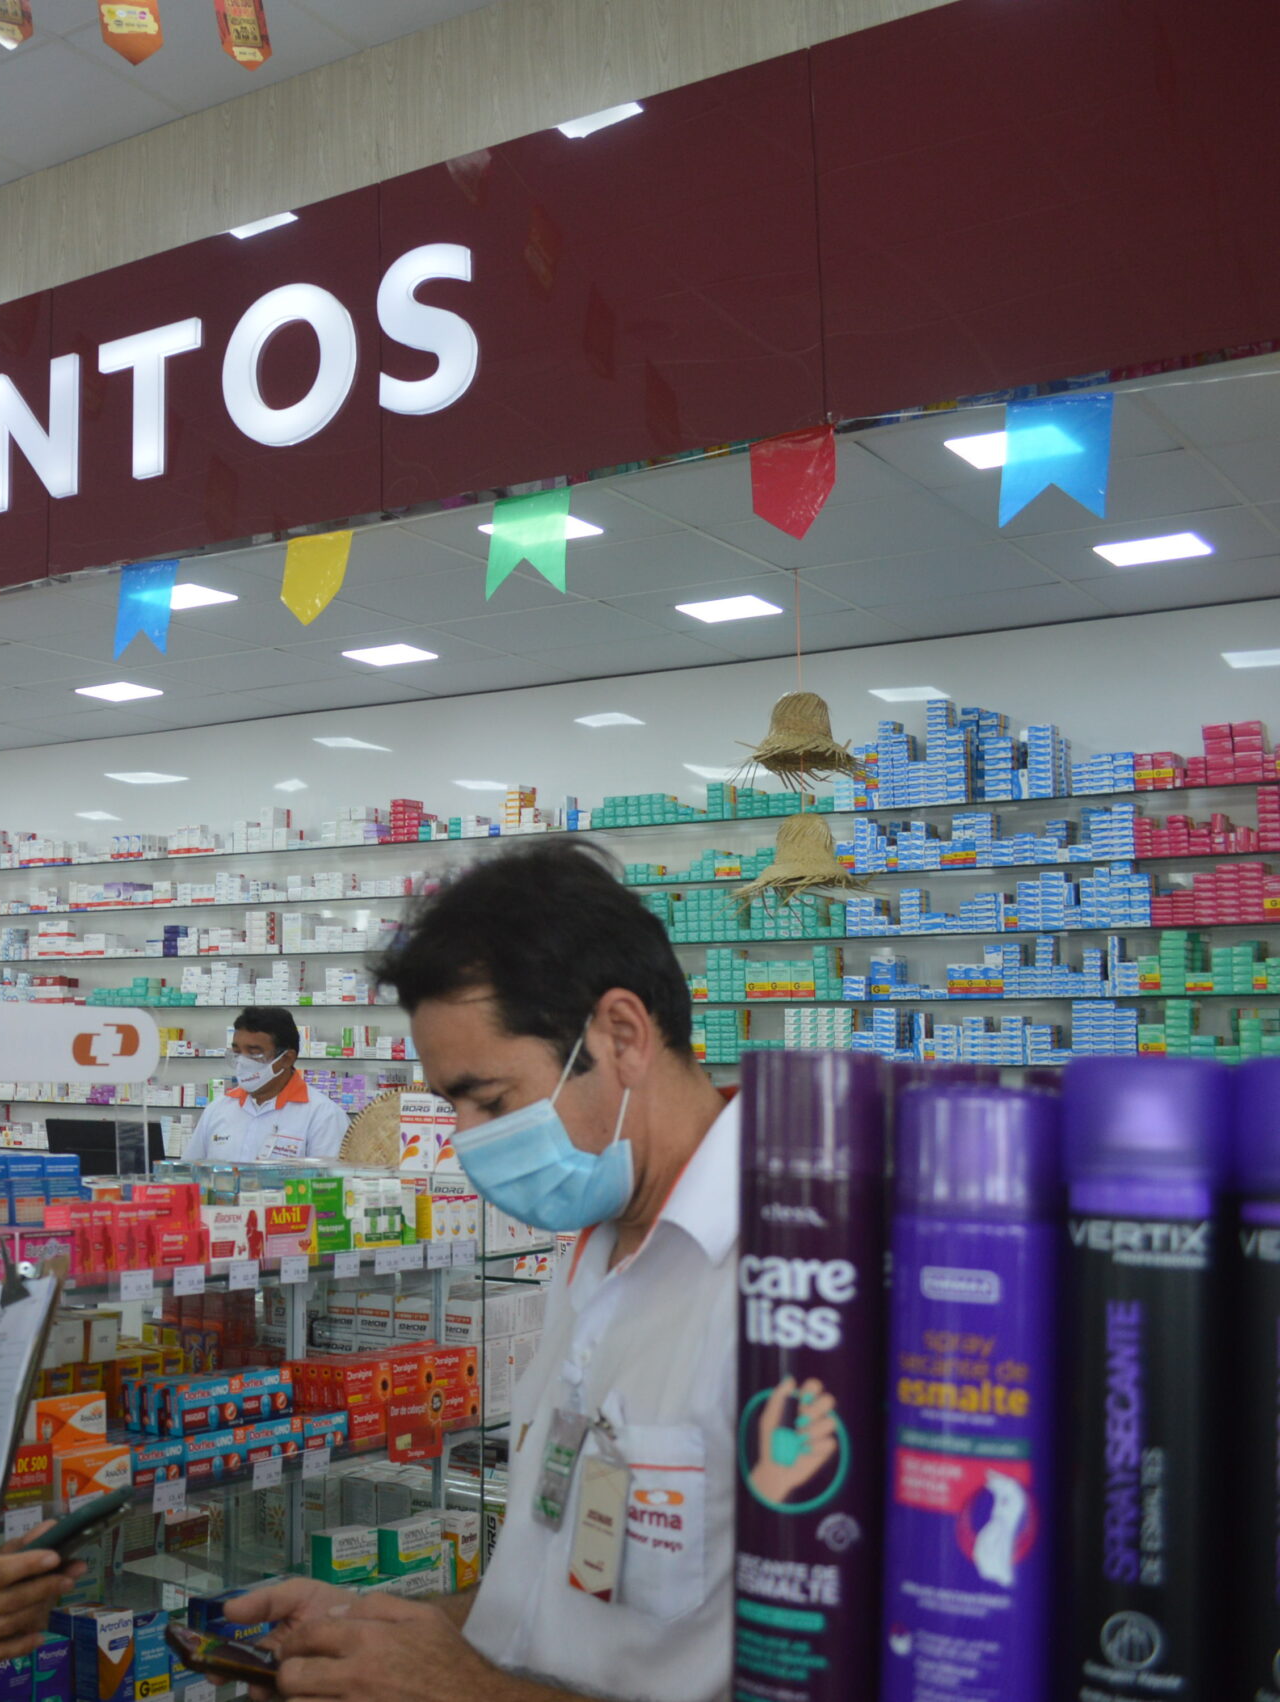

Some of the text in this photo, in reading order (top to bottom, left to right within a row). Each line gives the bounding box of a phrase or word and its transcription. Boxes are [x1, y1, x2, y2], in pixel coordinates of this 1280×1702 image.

[401, 1104, 431, 1113] BORG
[434, 1186, 465, 1195] BORG
[270, 1207, 301, 1225] Advil
[1069, 1219, 1210, 1253] VERTIX
[739, 1254, 858, 1304] care
[746, 1299, 842, 1351] liss
[923, 1330, 996, 1358] spray
[392, 1363, 418, 1374] Doralgina
[434, 1356, 459, 1367] Doralgina
[346, 1370, 373, 1381] Doralgina
[897, 1377, 1030, 1418] esmalte
[353, 1413, 380, 1424] Doralgina
[17, 1456, 48, 1473] DC 500
[652, 1535, 683, 1553] preço
[140, 1681, 151, 1698] G
